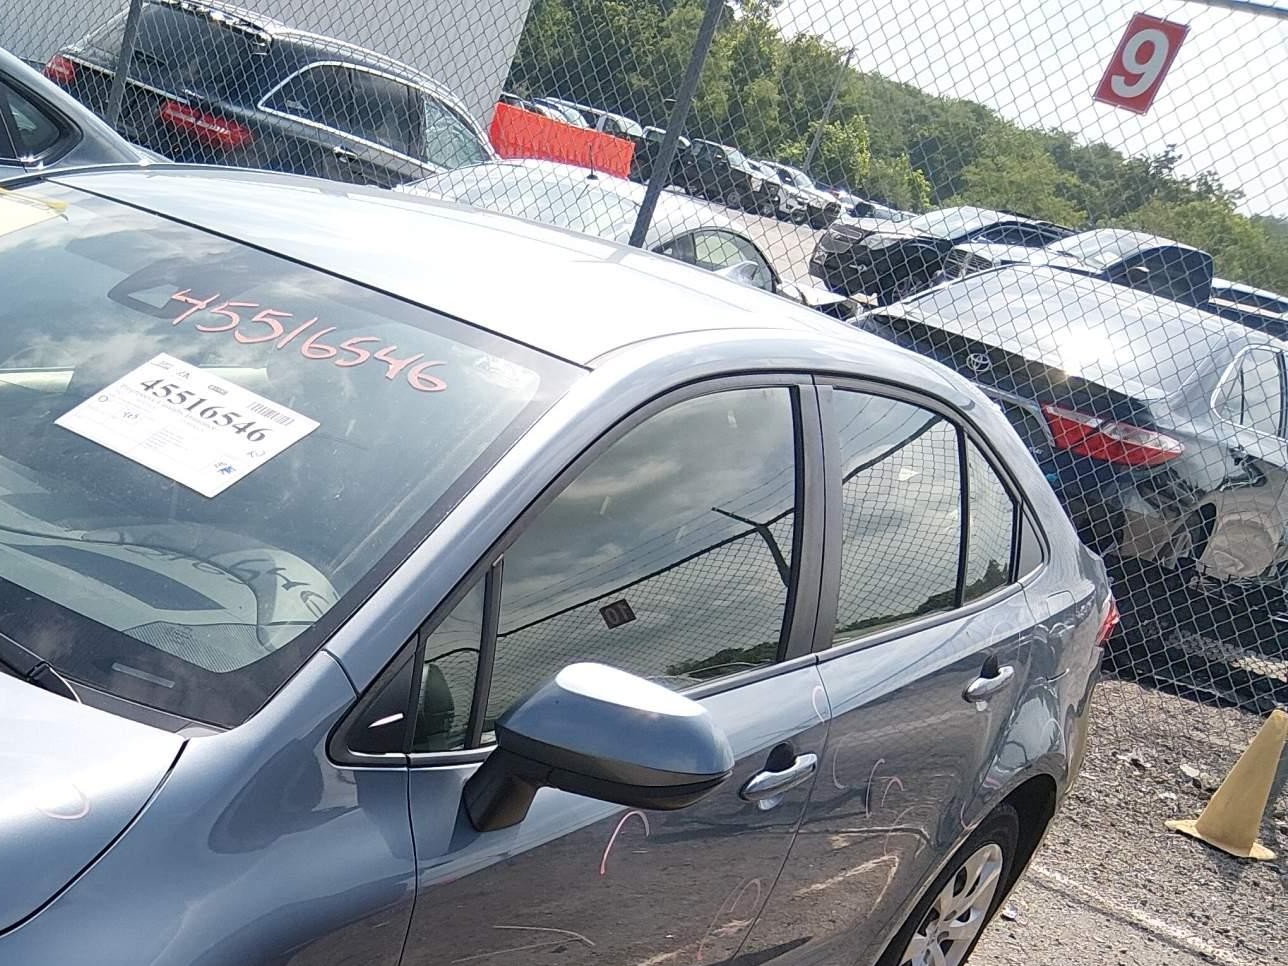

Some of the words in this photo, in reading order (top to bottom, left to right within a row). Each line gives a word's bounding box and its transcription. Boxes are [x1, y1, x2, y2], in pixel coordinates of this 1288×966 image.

[1111, 28, 1169, 98] 9
[171, 288, 447, 392] 45516546
[140, 379, 272, 442] 45516546
